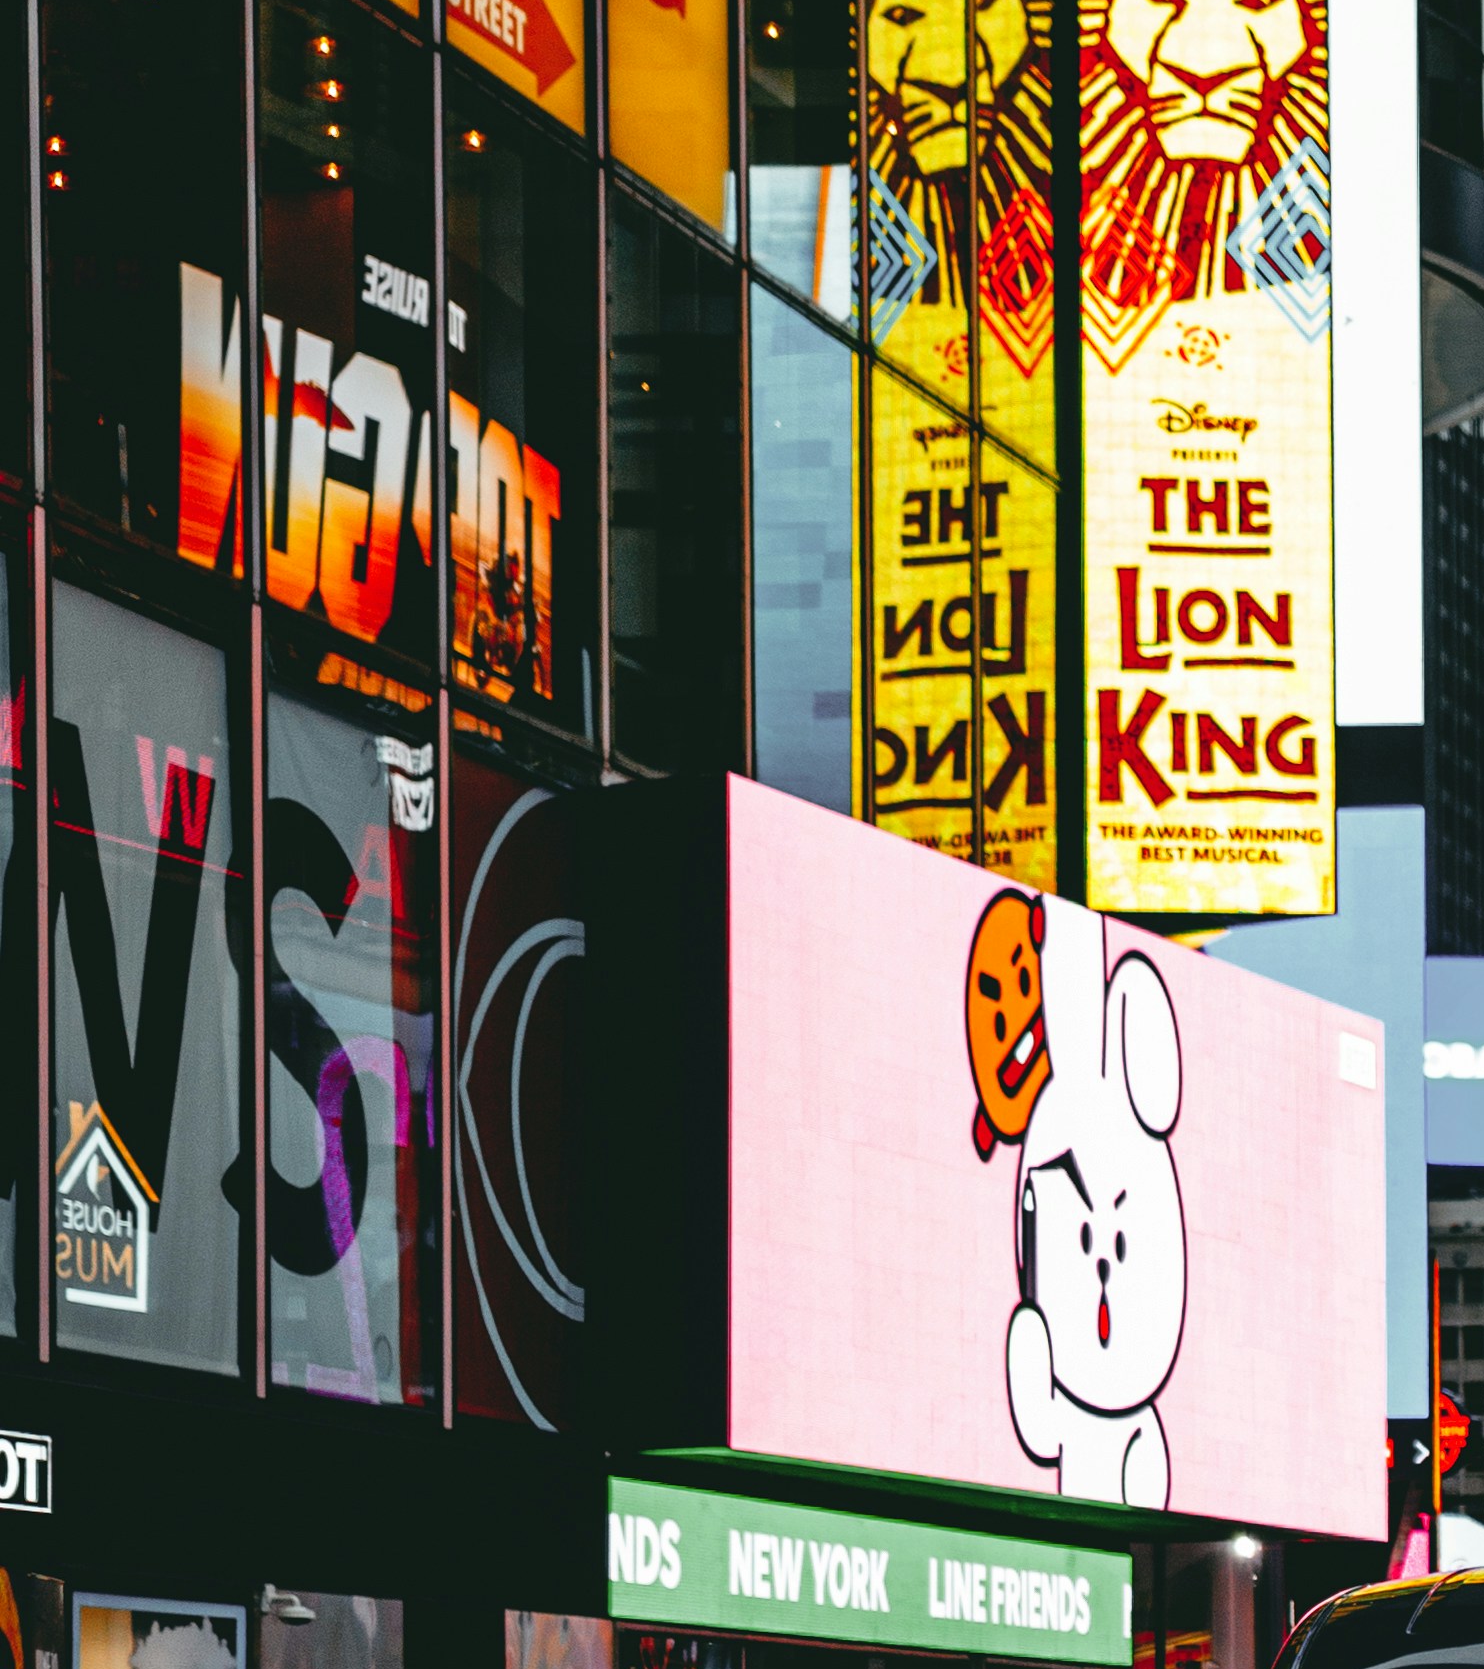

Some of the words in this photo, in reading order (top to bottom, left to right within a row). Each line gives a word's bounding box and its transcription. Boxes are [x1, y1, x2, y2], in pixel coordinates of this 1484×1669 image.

[1150, 398, 1258, 443] Disney
[1140, 478, 1271, 535] THE
[1116, 566, 1292, 672] LION
[1097, 688, 1320, 809] KING
[1100, 824, 1138, 841] THE
[1143, 825, 1323, 844] AWARD-WINNING
[1140, 846, 1184, 863] BEST
[1191, 846, 1283, 864] MUSICAL
[727, 1528, 808, 1602] NEW
[810, 1541, 890, 1614] YORK
[929, 1558, 989, 1623] LINE
[991, 1568, 1091, 1635] FRIENDS
